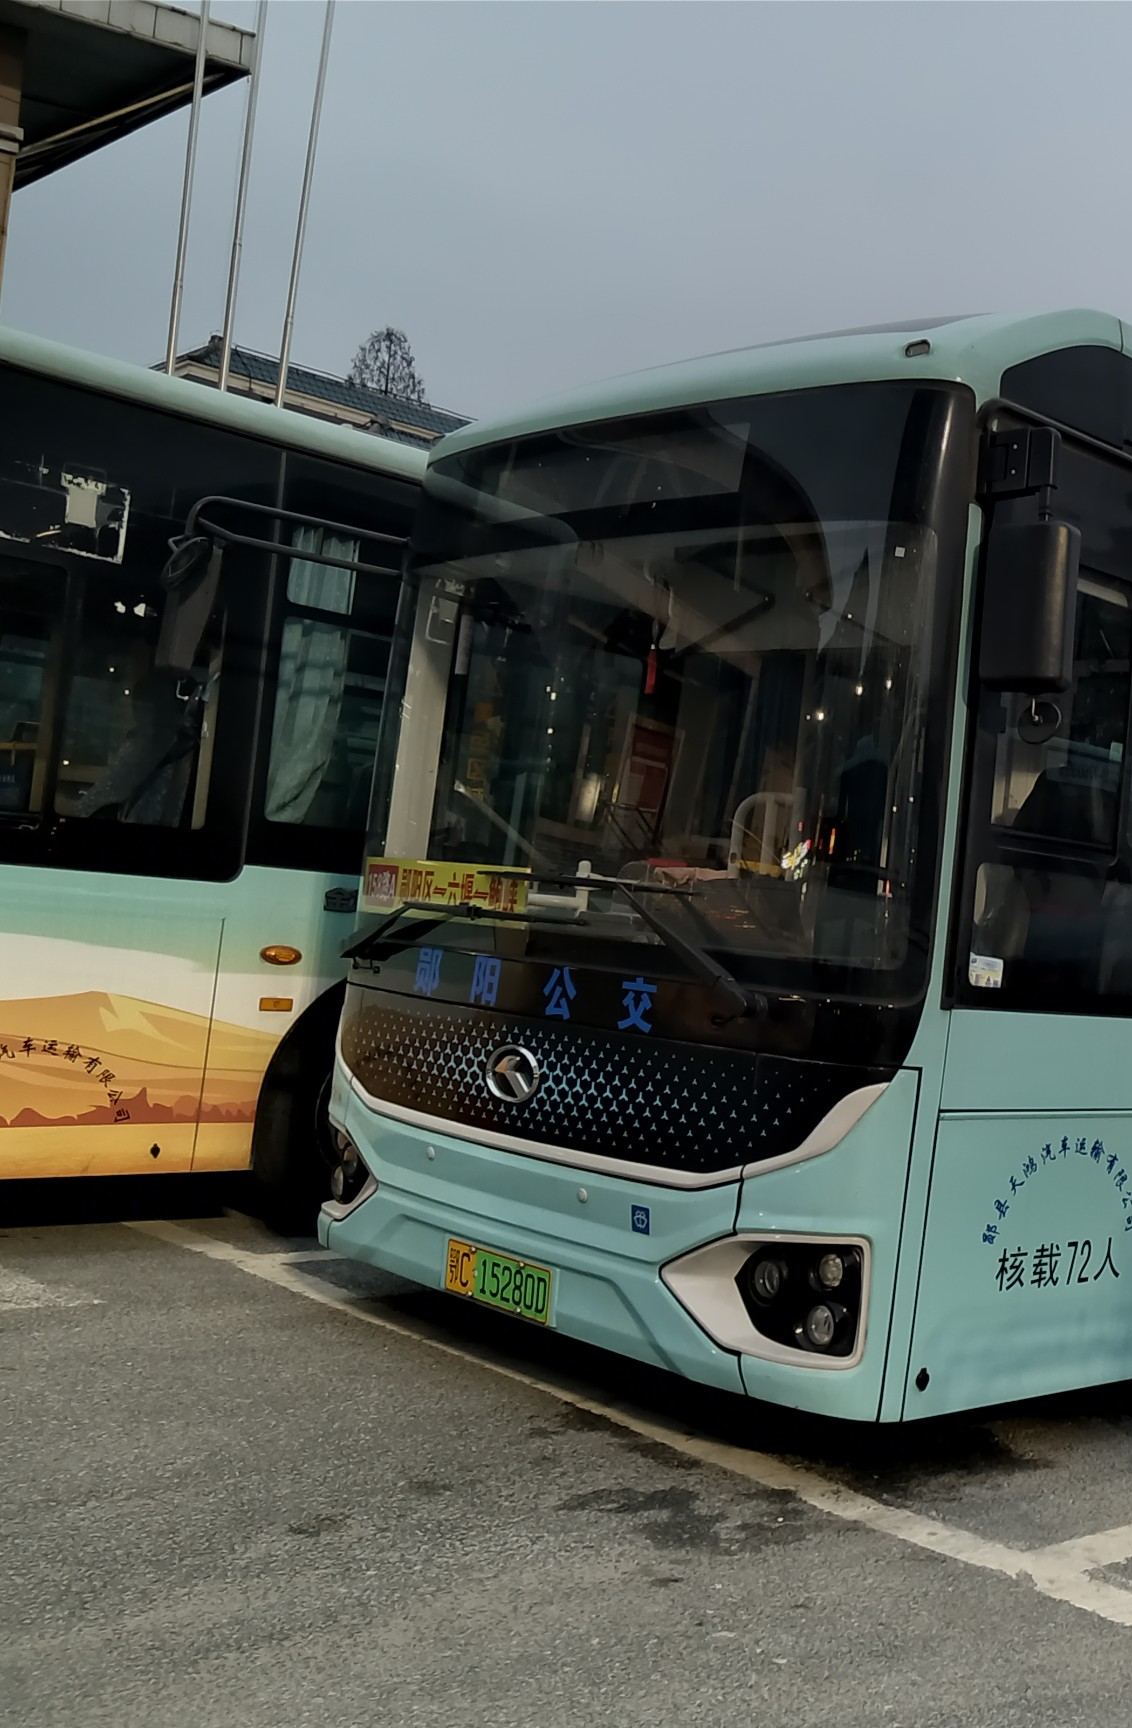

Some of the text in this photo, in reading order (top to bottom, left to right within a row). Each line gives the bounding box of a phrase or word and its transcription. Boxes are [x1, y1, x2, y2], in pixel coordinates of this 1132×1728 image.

[413, 946, 657, 1034] 郧阳公交
[995, 1237, 1120, 1292] 核载72人
